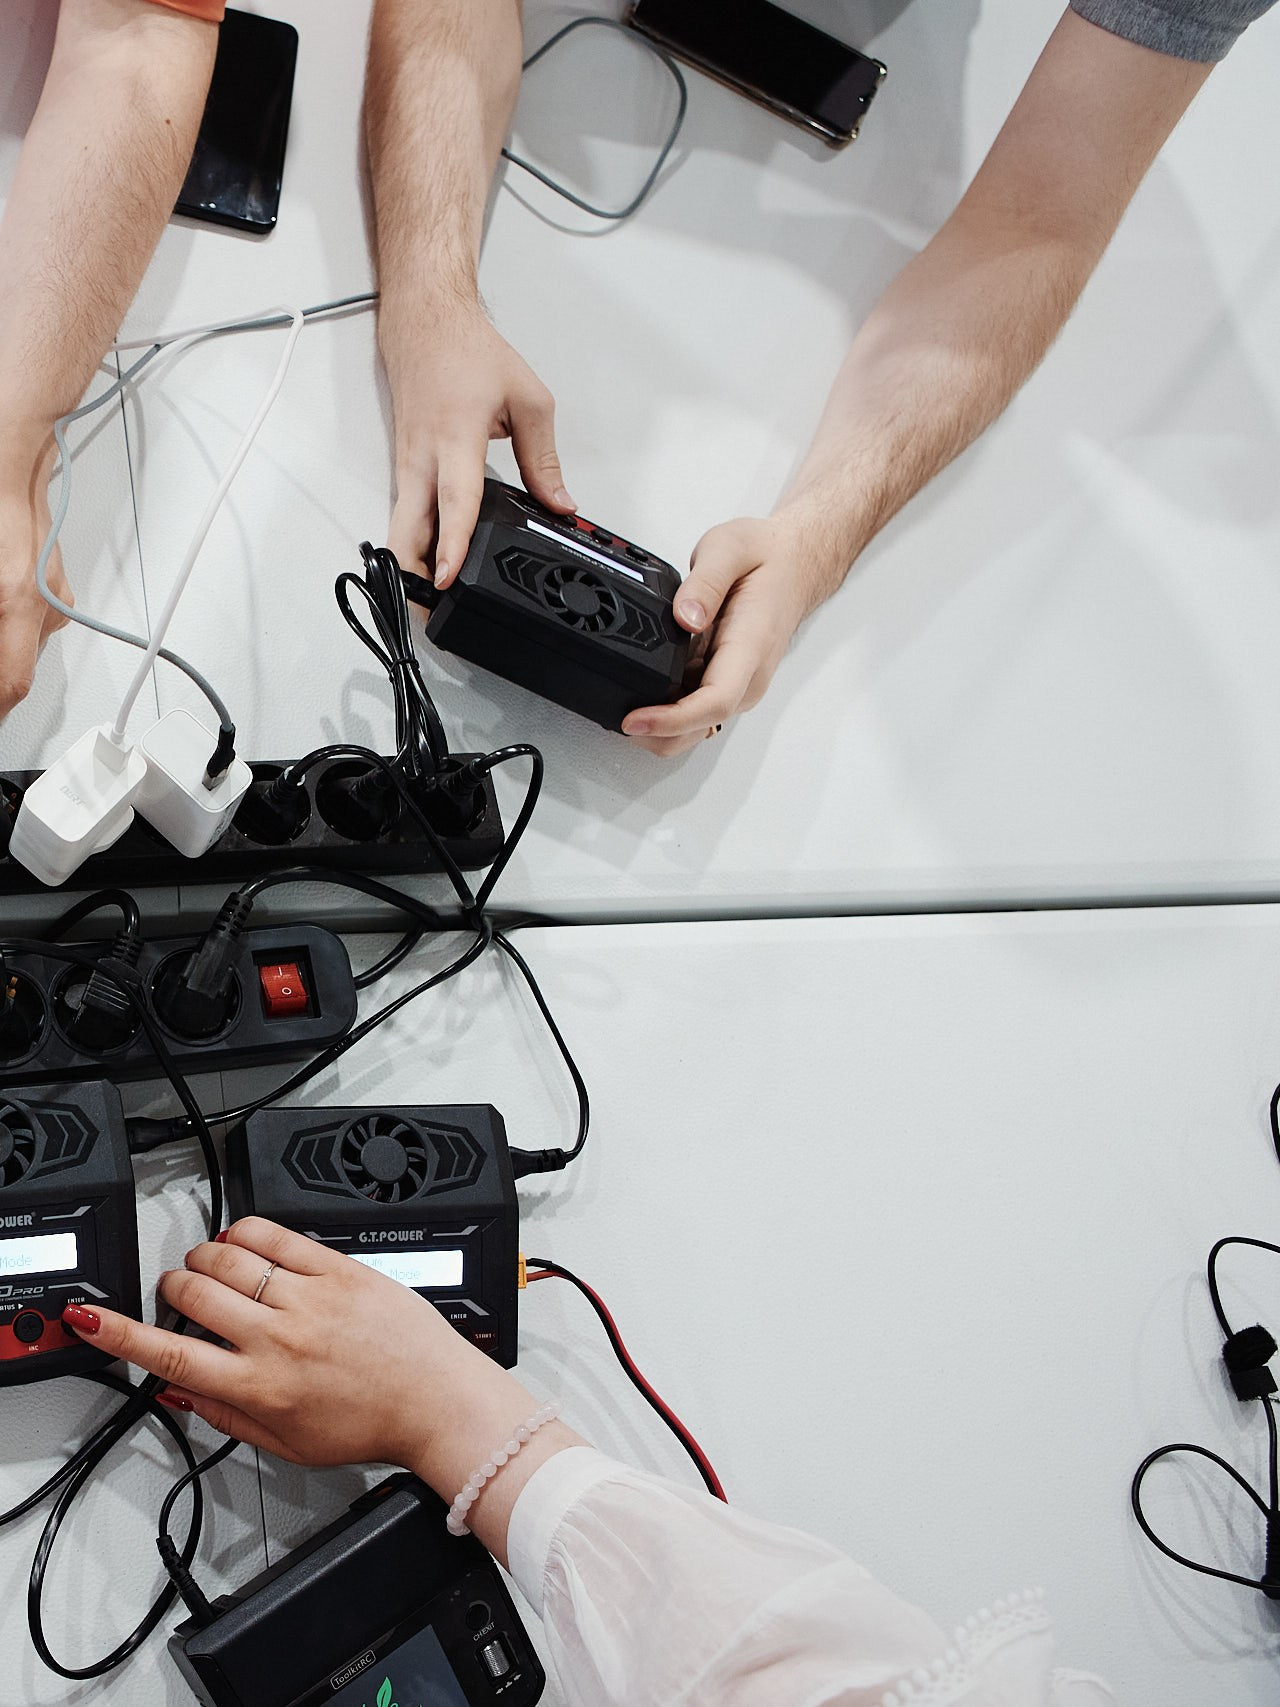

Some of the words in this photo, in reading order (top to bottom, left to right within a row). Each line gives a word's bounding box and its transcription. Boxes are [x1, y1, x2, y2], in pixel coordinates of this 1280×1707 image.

[358, 1230, 424, 1243] G.T.POWER
[0, 1254, 33, 1268] Mode
[472, 1630, 483, 1642] CH
[480, 1621, 496, 1637] EXIT
[333, 1654, 373, 1687] ToolkitRC
